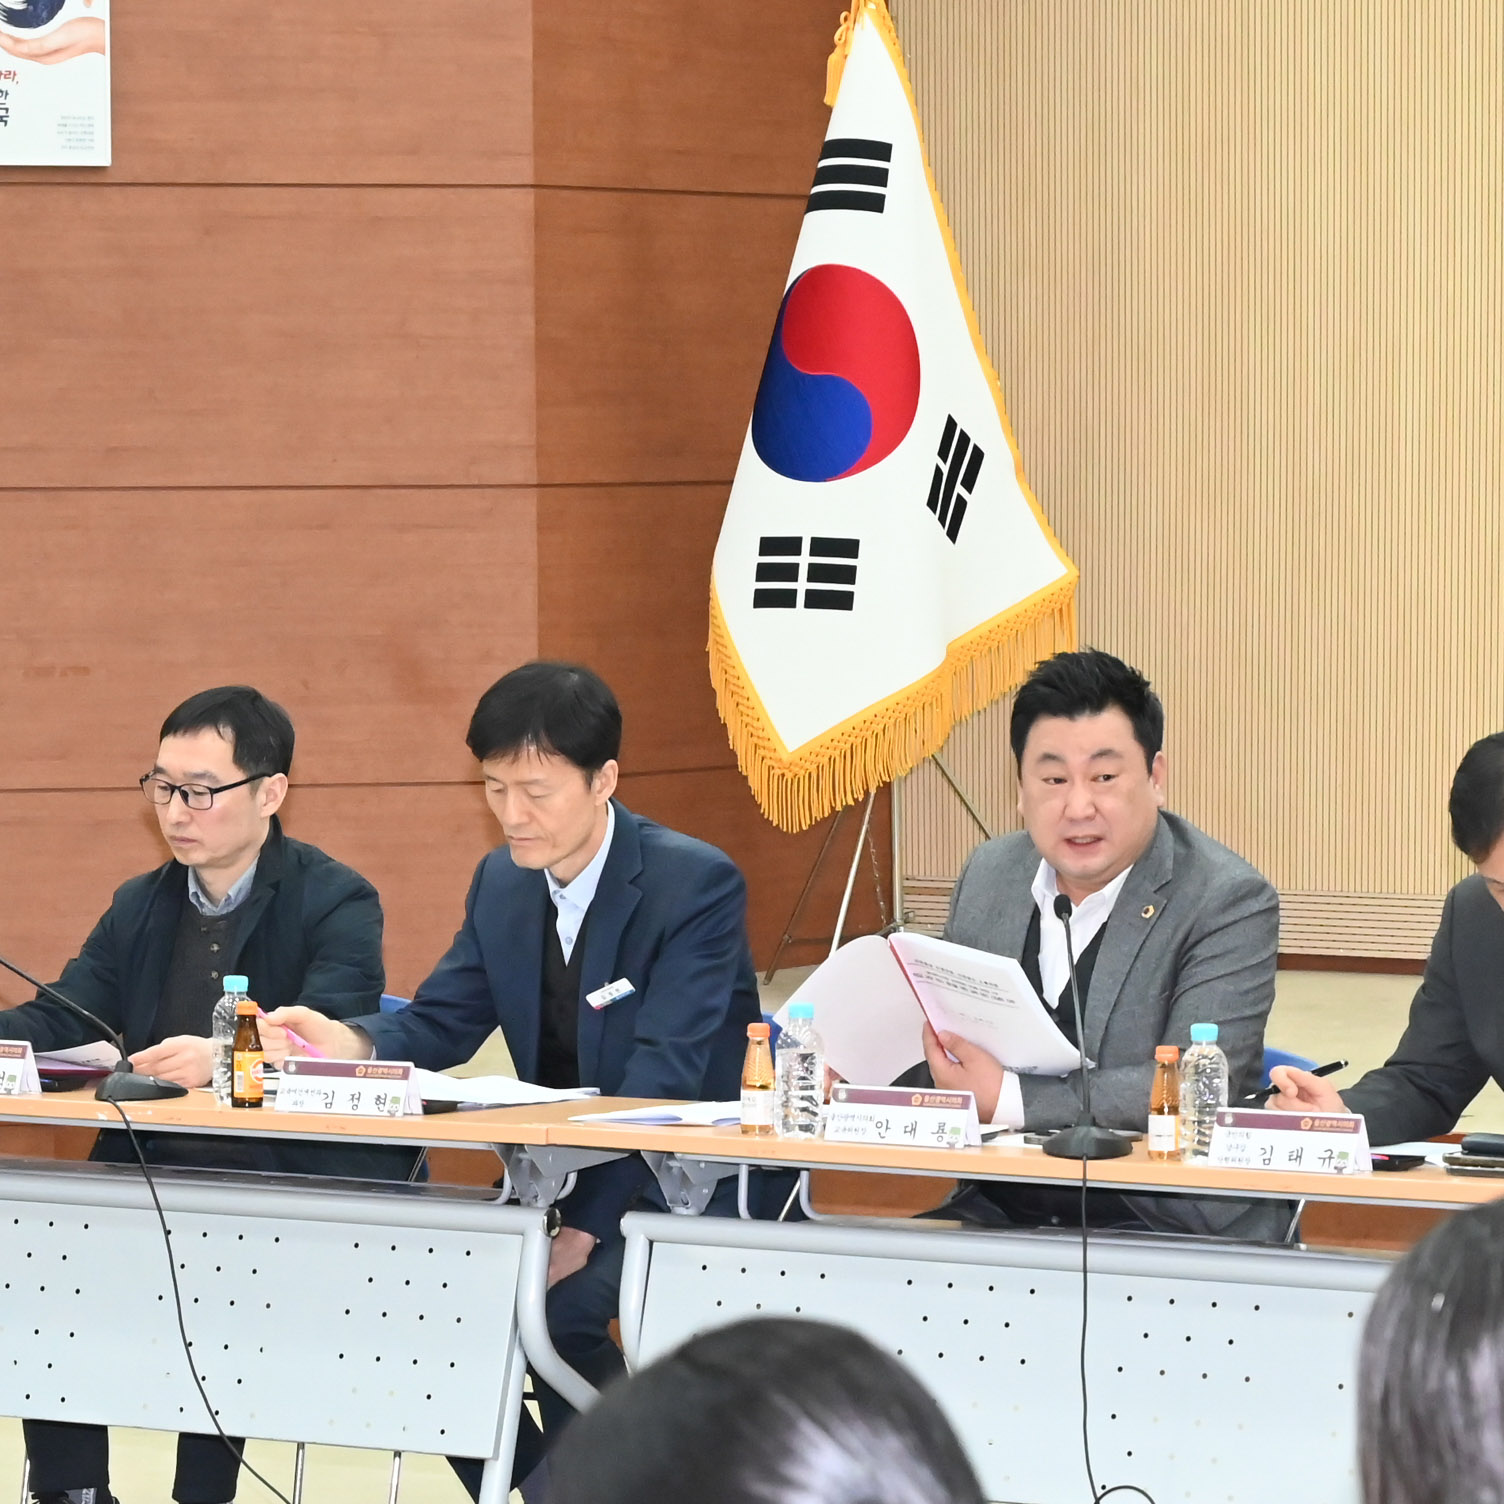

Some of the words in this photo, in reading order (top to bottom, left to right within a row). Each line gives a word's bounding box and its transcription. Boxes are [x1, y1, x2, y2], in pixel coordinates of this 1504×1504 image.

[321, 1090, 387, 1112] 김정현
[875, 1119, 947, 1143] 안대룡
[1259, 1145, 1336, 1168] 김태규
